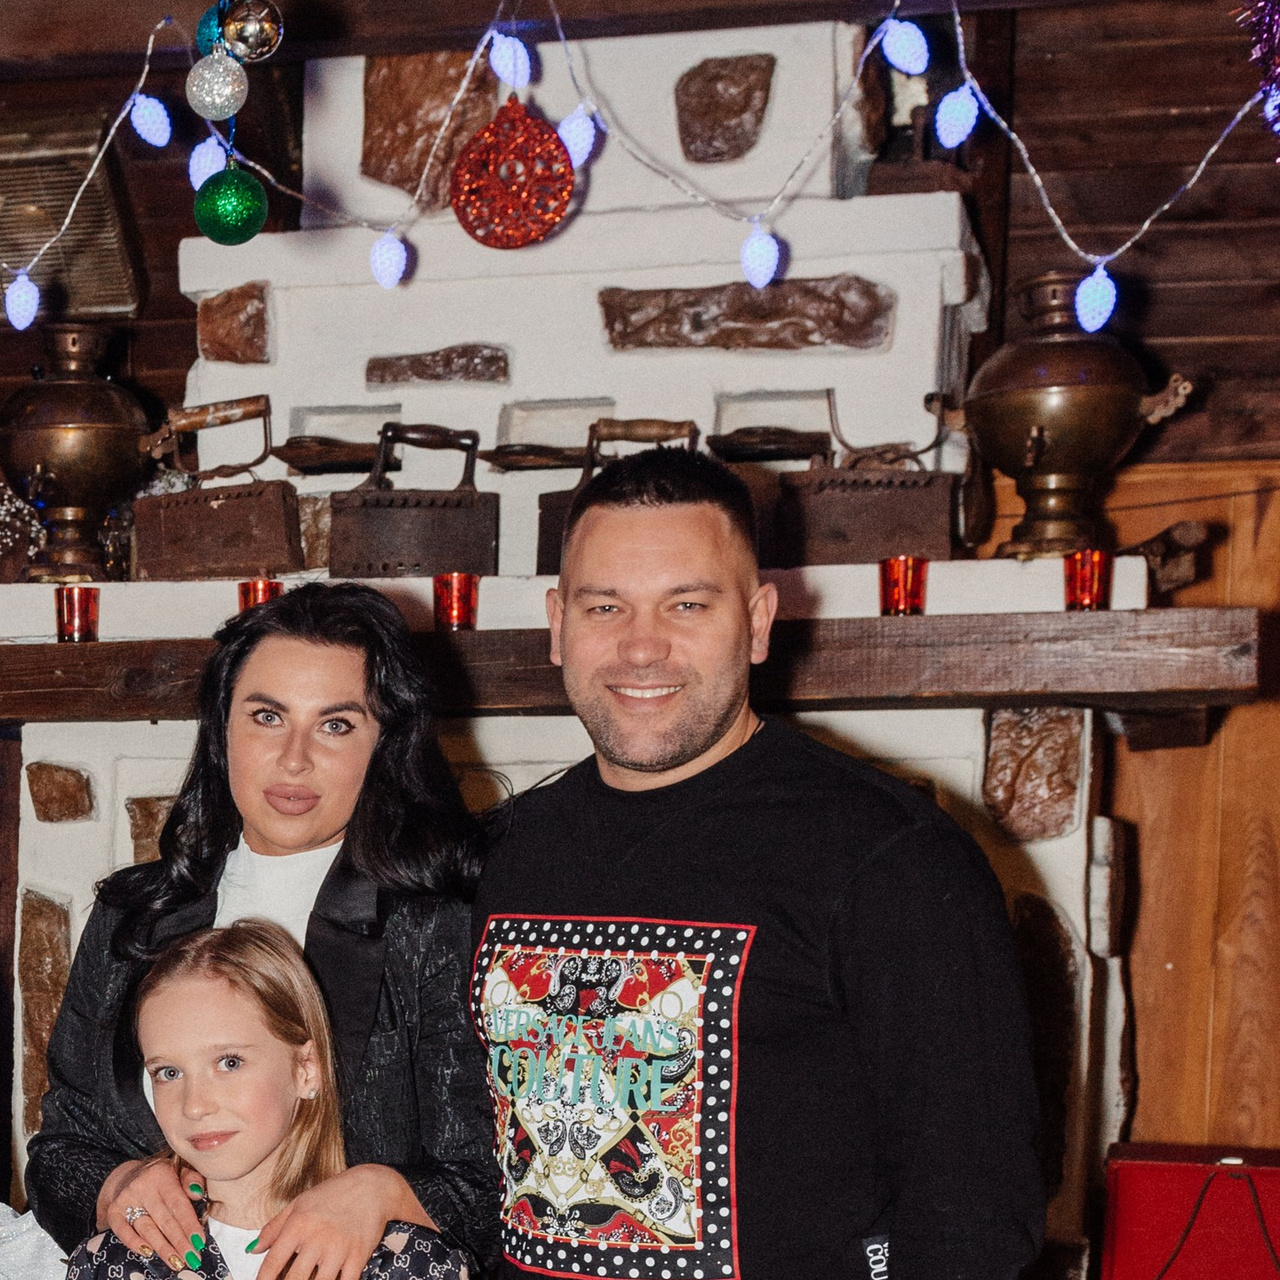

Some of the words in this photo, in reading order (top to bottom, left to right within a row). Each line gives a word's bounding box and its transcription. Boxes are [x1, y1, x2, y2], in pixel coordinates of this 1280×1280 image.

[492, 1008, 590, 1047] VERSACE
[593, 1017, 679, 1054] JEANS
[491, 1045, 677, 1111] COUTURE
